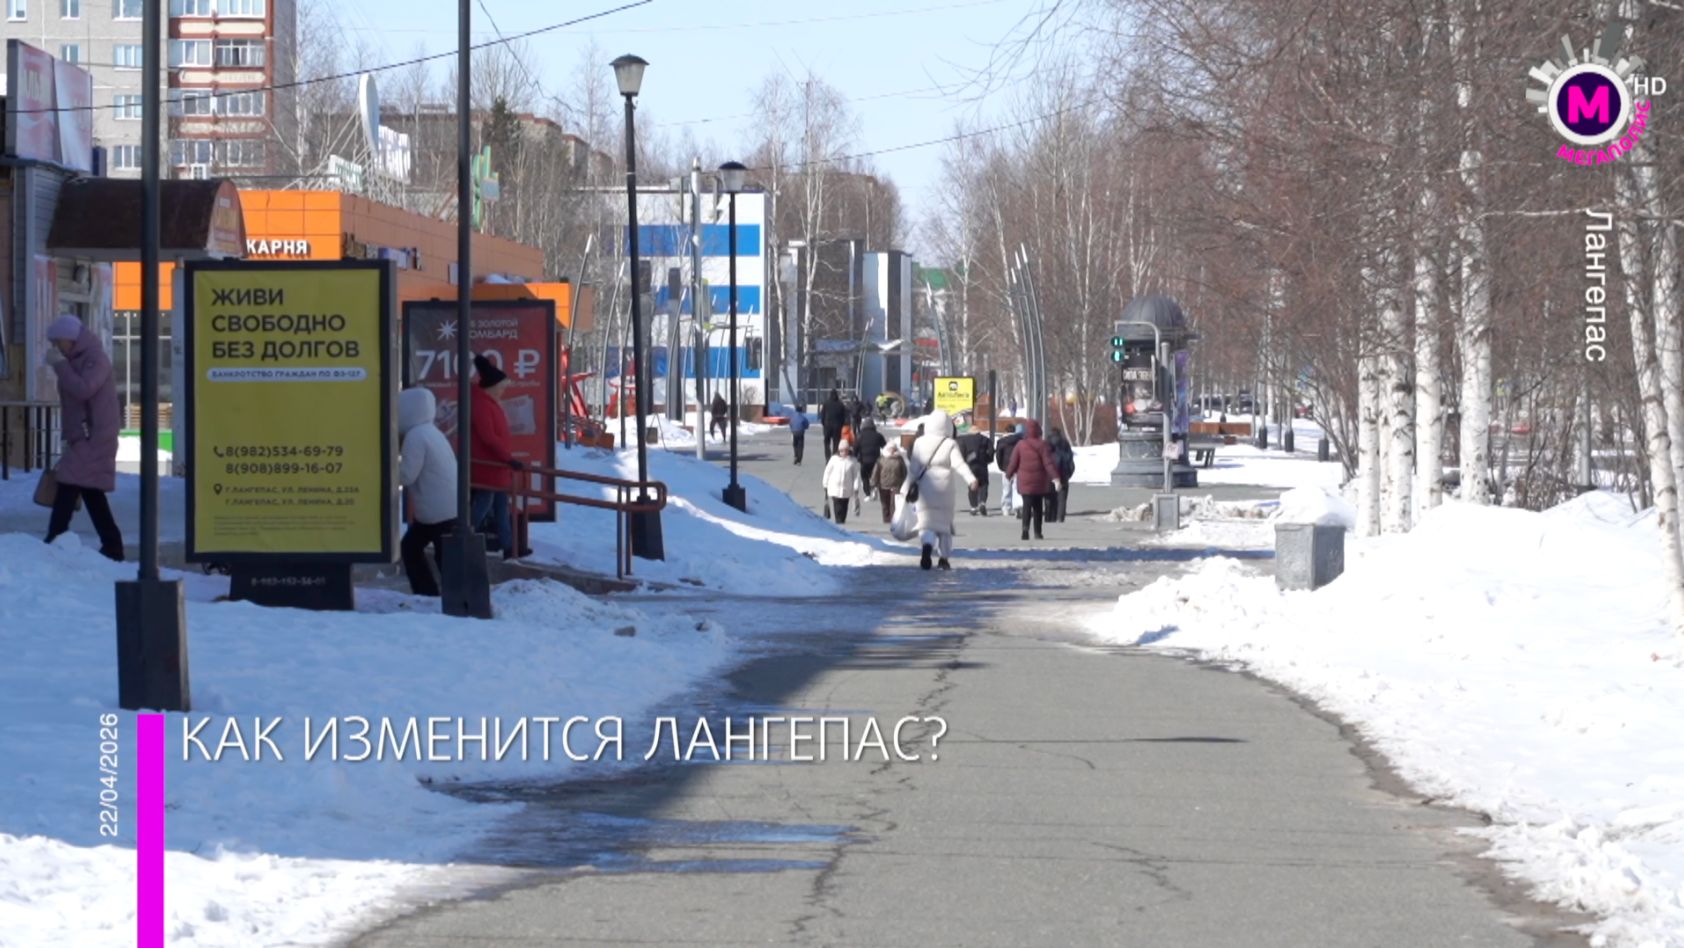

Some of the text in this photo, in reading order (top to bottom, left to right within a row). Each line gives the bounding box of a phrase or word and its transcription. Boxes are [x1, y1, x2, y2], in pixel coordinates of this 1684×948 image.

[211, 288, 284, 306] ЖИВИ
[211, 314, 346, 335] СВОБОДНО
[469, 330, 518, 339] ОМБАРД
[212, 340, 360, 361] БЕЗ ДОЛГОВ
[212, 369, 273, 378] БАНКРОТСТВО
[275, 369, 316, 379] ГРАЖДАН
[318, 369, 330, 378] ПО
[225, 445, 344, 458] 8(982)534-69-79
[225, 462, 343, 475] 8(908)899-16-07
